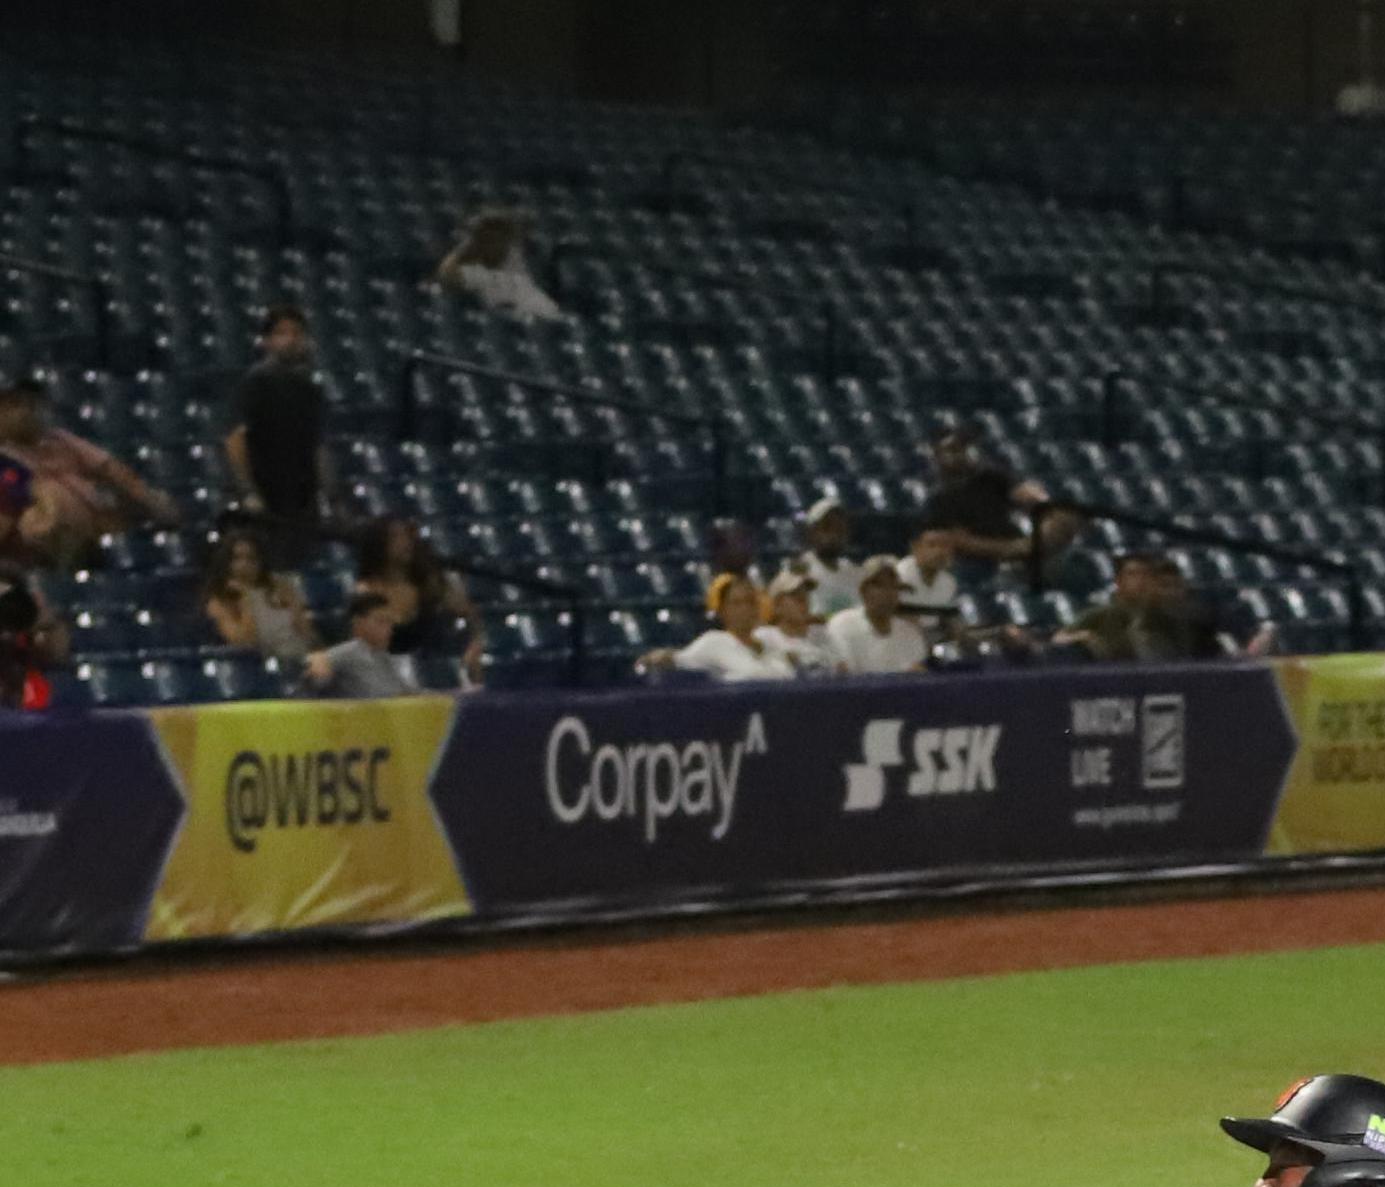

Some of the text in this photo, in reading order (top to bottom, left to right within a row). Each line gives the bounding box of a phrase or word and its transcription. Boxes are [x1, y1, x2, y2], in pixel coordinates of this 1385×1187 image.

[225, 746, 392, 853] @WBSC
[545, 715, 747, 843] Corpay
[907, 724, 1002, 797] SSK
